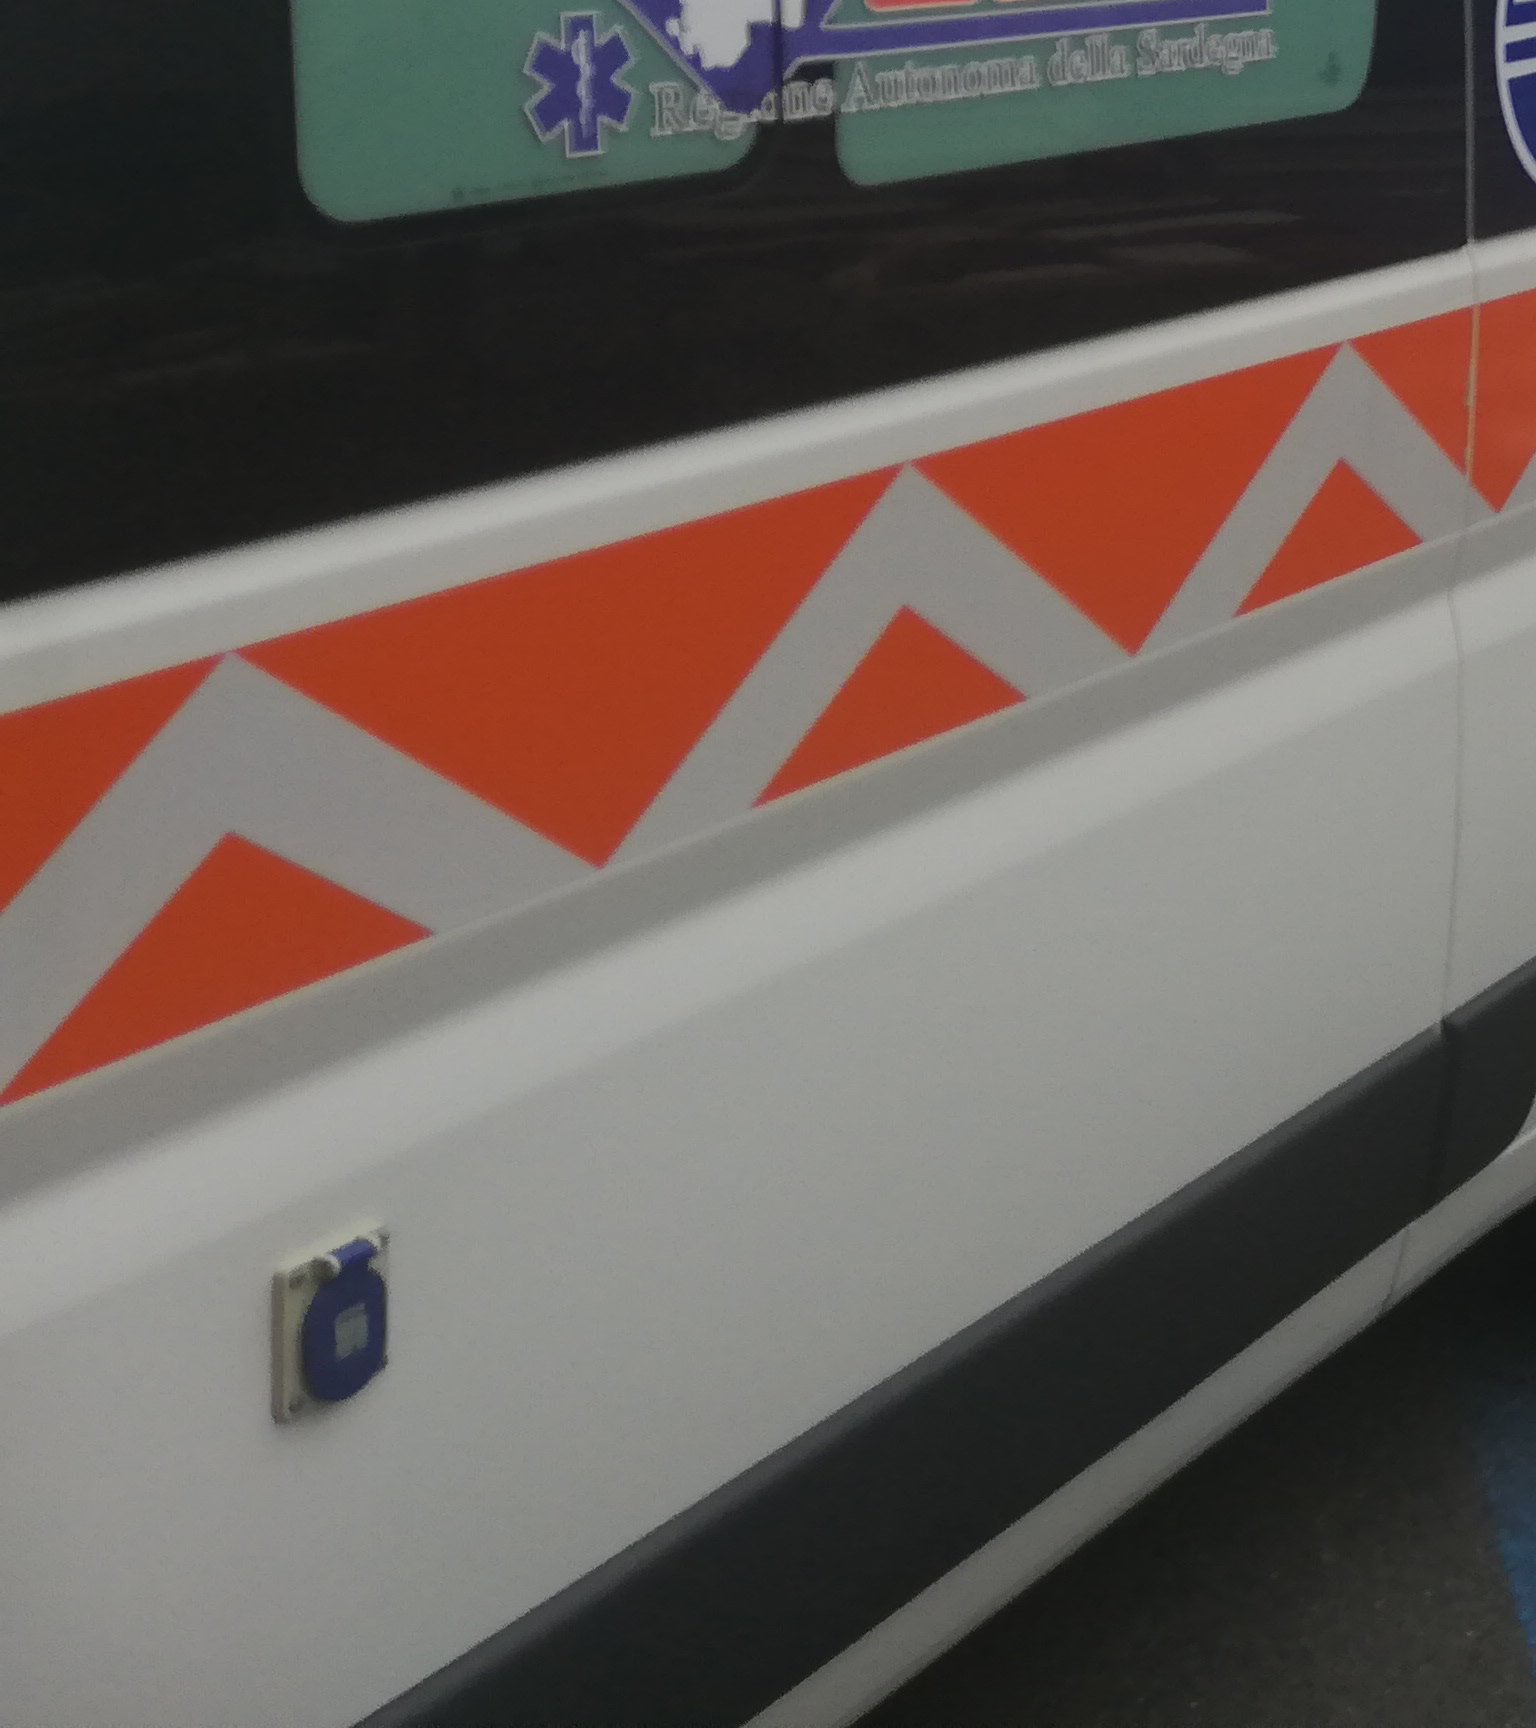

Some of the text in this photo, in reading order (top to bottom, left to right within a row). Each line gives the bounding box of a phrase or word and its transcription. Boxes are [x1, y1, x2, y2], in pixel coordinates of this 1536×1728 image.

[840, 55, 1040, 113] Autonoma
[1047, 32, 1131, 86] della
[1136, 22, 1278, 76] Sardegna
